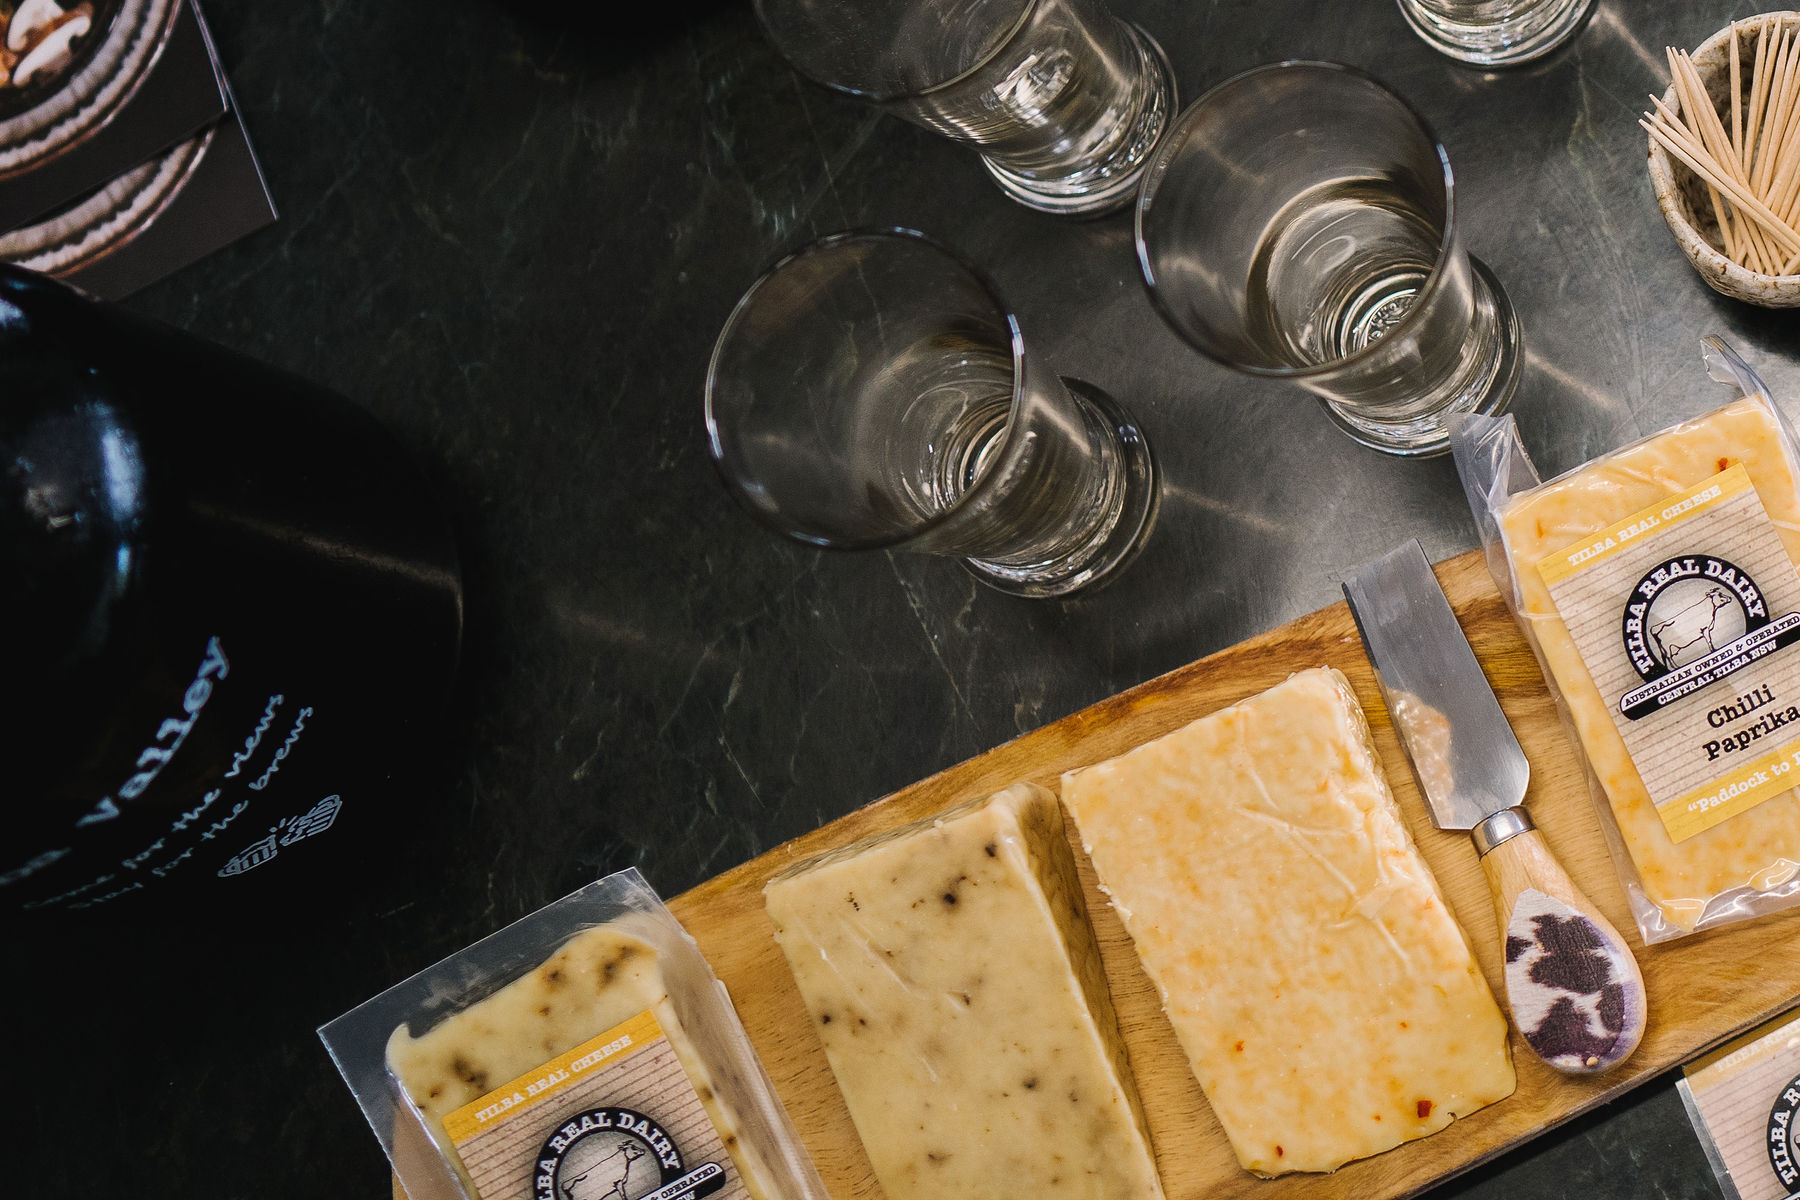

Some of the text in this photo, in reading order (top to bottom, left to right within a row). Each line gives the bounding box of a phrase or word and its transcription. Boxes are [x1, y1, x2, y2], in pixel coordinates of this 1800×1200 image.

[1567, 483, 1723, 568] TILBA REAL CHEESE
[1626, 557, 1766, 676] TILBA REAL DAIRY
[1624, 666, 1693, 707] AUSTRALIAN
[1694, 648, 1735, 675] OWNED
[1735, 643, 1744, 653] &
[1657, 638, 1778, 706] CENTRAL TILBA NSW
[1706, 683, 1776, 730] Chilli
[76, 635, 230, 828] Valley
[173, 788, 222, 833] the
[224, 693, 284, 779] views
[1771, 757, 1792, 776] to
[200, 800, 249, 842] the
[248, 706, 314, 791] brews
[474, 1034, 633, 1125] TILBA REAL CHEESE
[1714, 1047, 1758, 1073] TILBA
[549, 1111, 612, 1154] REAL
[616, 1112, 681, 1170] DAIRY
[1770, 1109, 1800, 1186] TILBA
[660, 1165, 717, 1199] OPERATED
